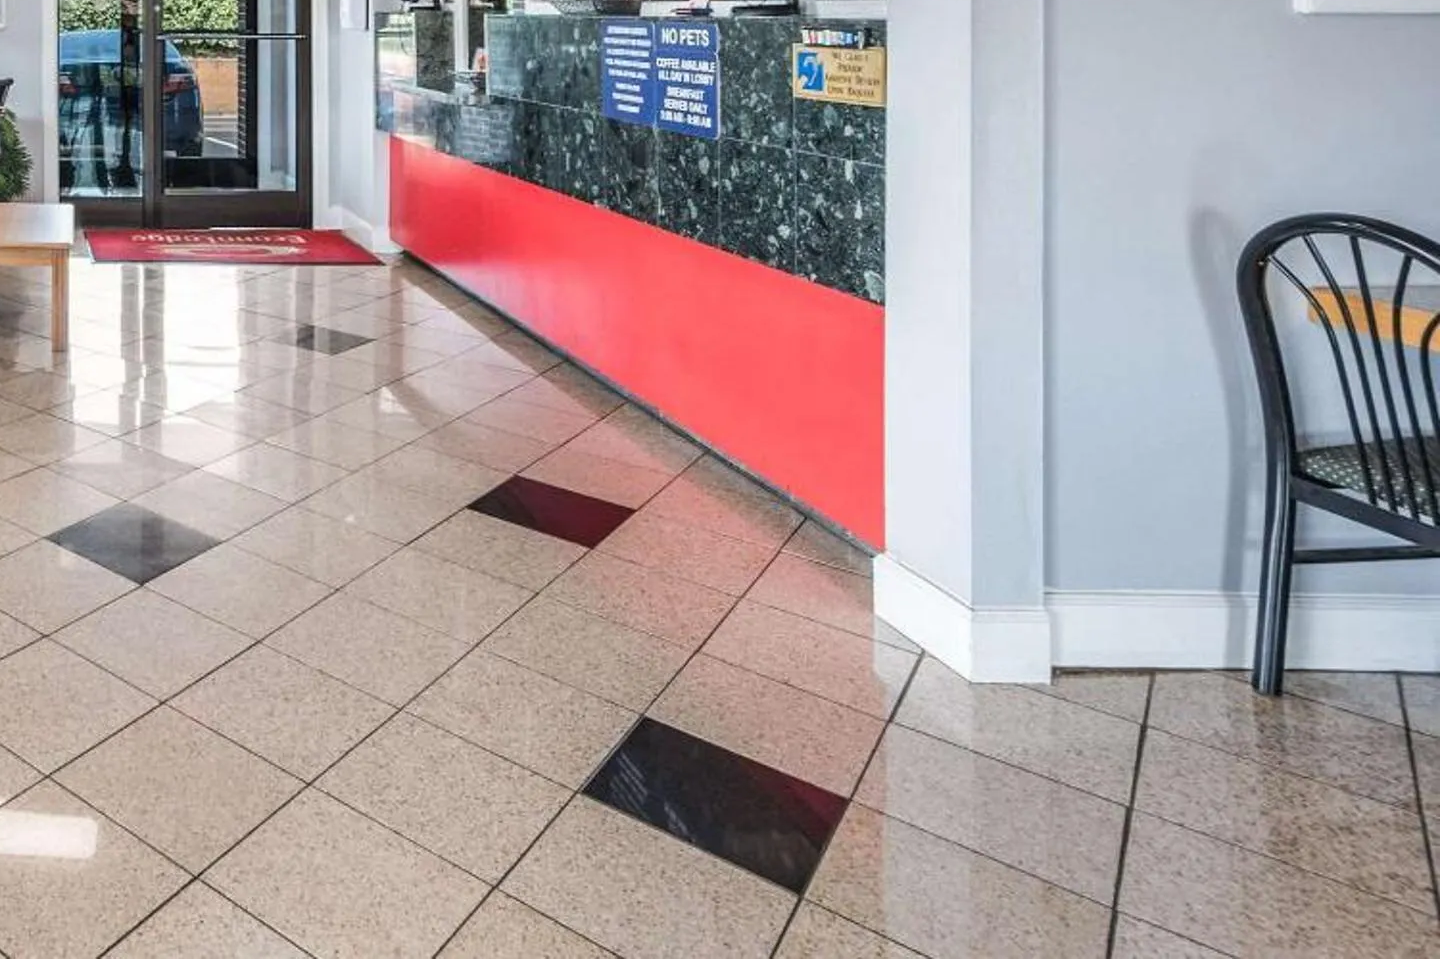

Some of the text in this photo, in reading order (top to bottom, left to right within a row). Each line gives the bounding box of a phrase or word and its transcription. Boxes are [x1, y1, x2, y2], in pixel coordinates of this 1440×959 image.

[661, 27, 710, 47] NO PETS
[656, 57, 680, 69] COFFEE
